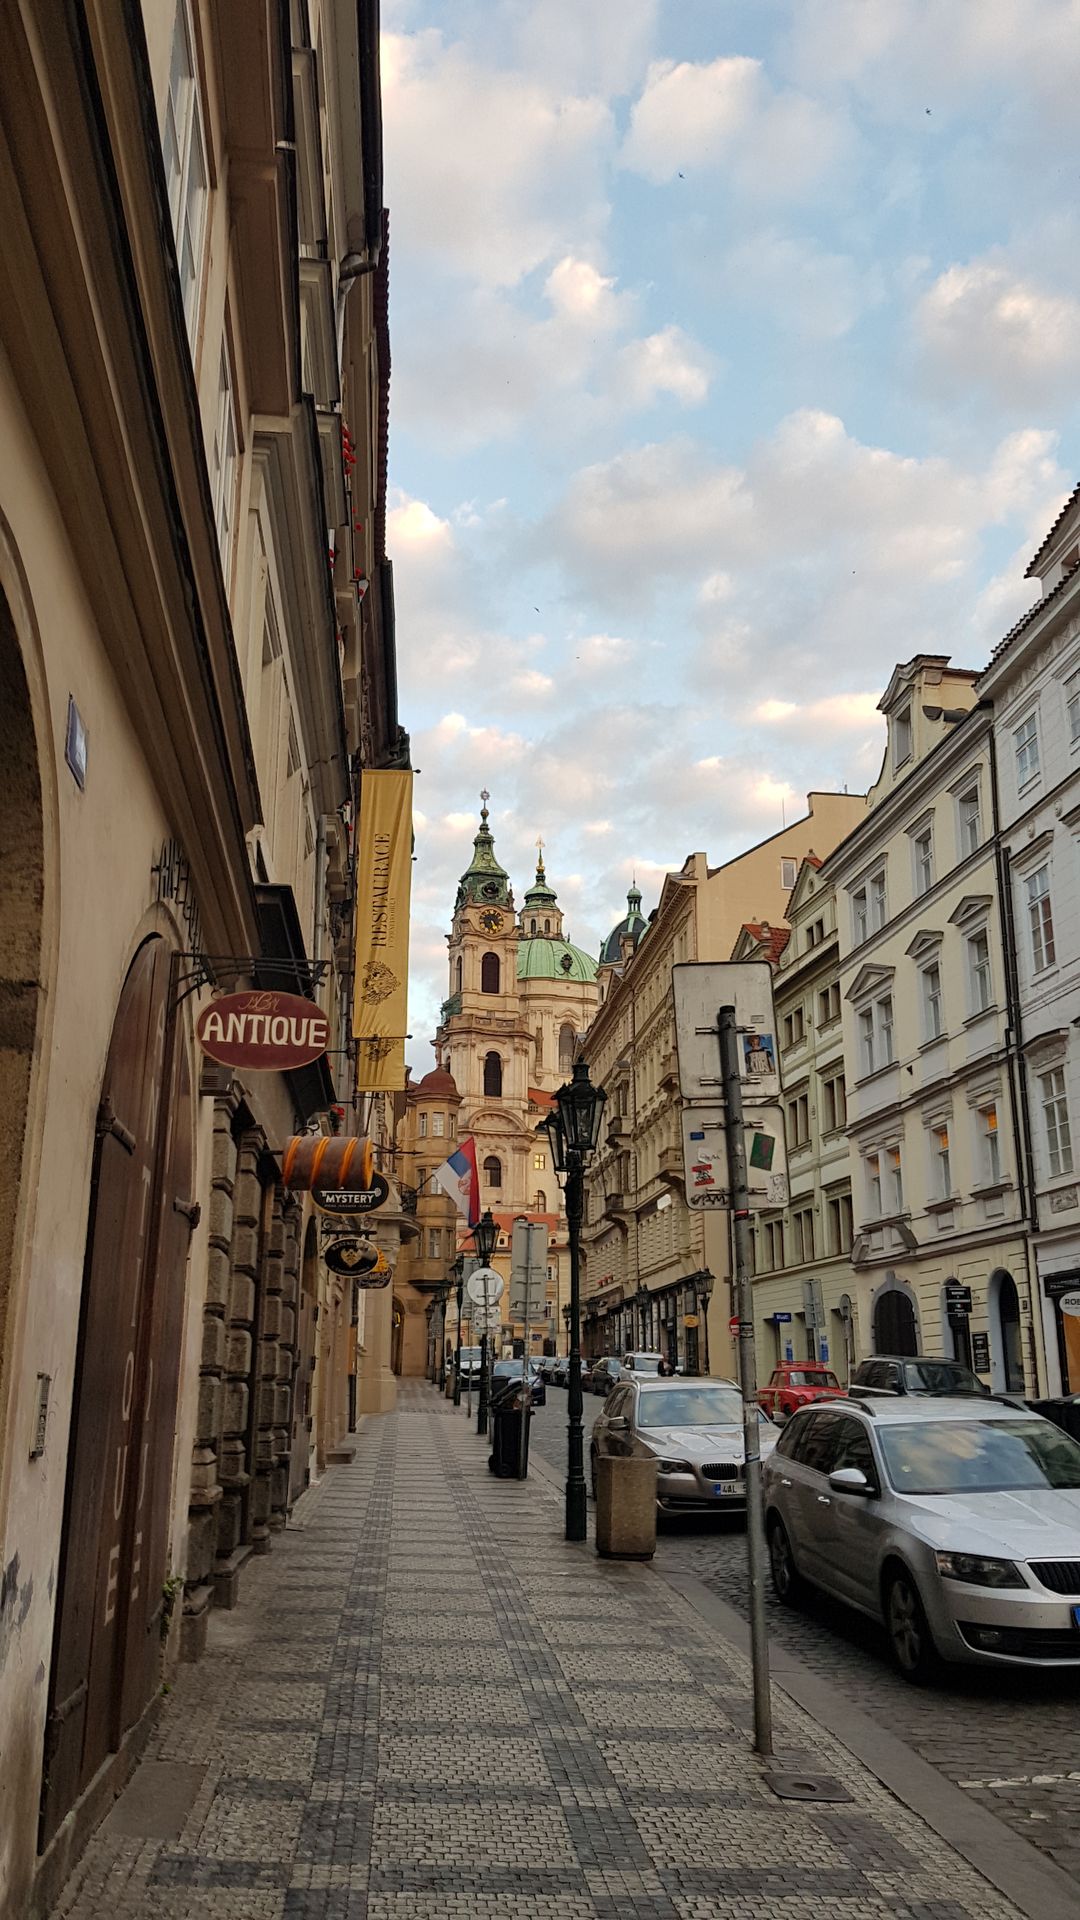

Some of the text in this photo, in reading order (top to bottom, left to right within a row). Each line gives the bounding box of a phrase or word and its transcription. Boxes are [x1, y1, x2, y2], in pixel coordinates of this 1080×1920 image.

[371, 833, 390, 948] RESTAURACE
[202, 1011, 327, 1048] ANTIQUE
[325, 1194, 374, 1204] MYSTERY
